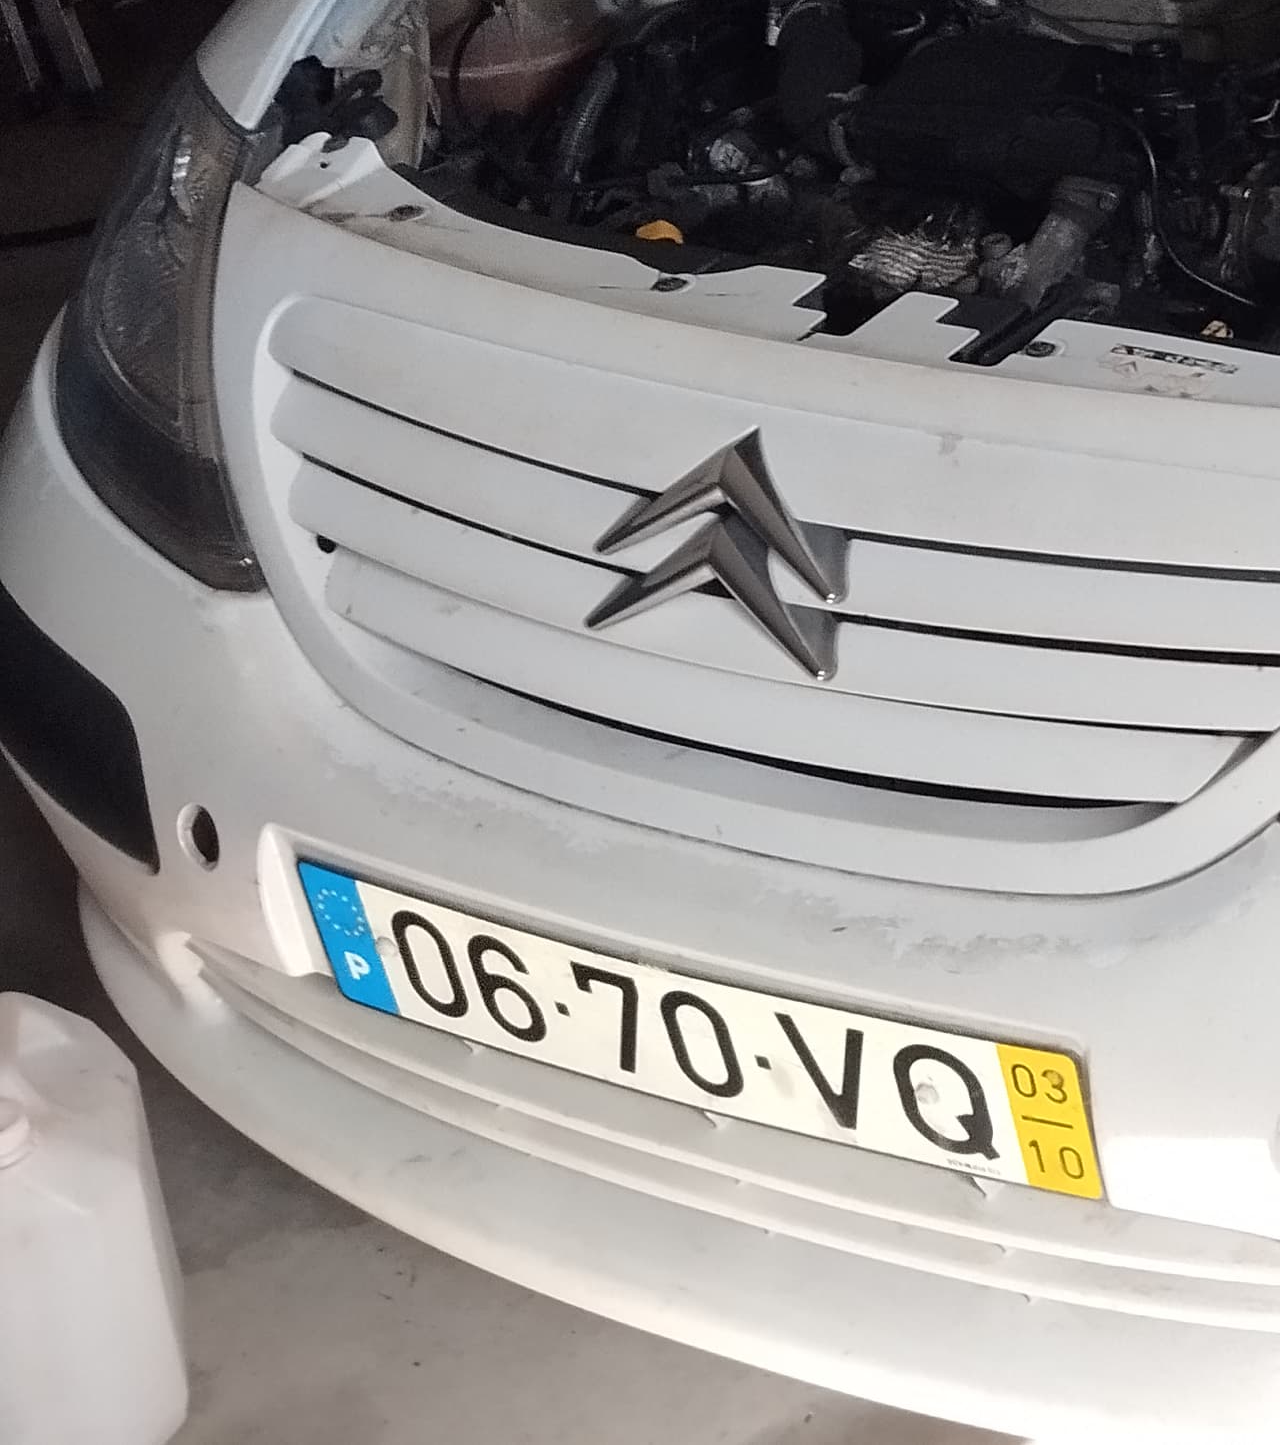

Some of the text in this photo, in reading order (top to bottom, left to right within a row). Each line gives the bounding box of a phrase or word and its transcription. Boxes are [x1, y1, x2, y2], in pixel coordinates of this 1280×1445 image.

[343, 950, 371, 981] P
[1011, 1063, 1068, 1104] 03
[1028, 1139, 1085, 1180] 10
